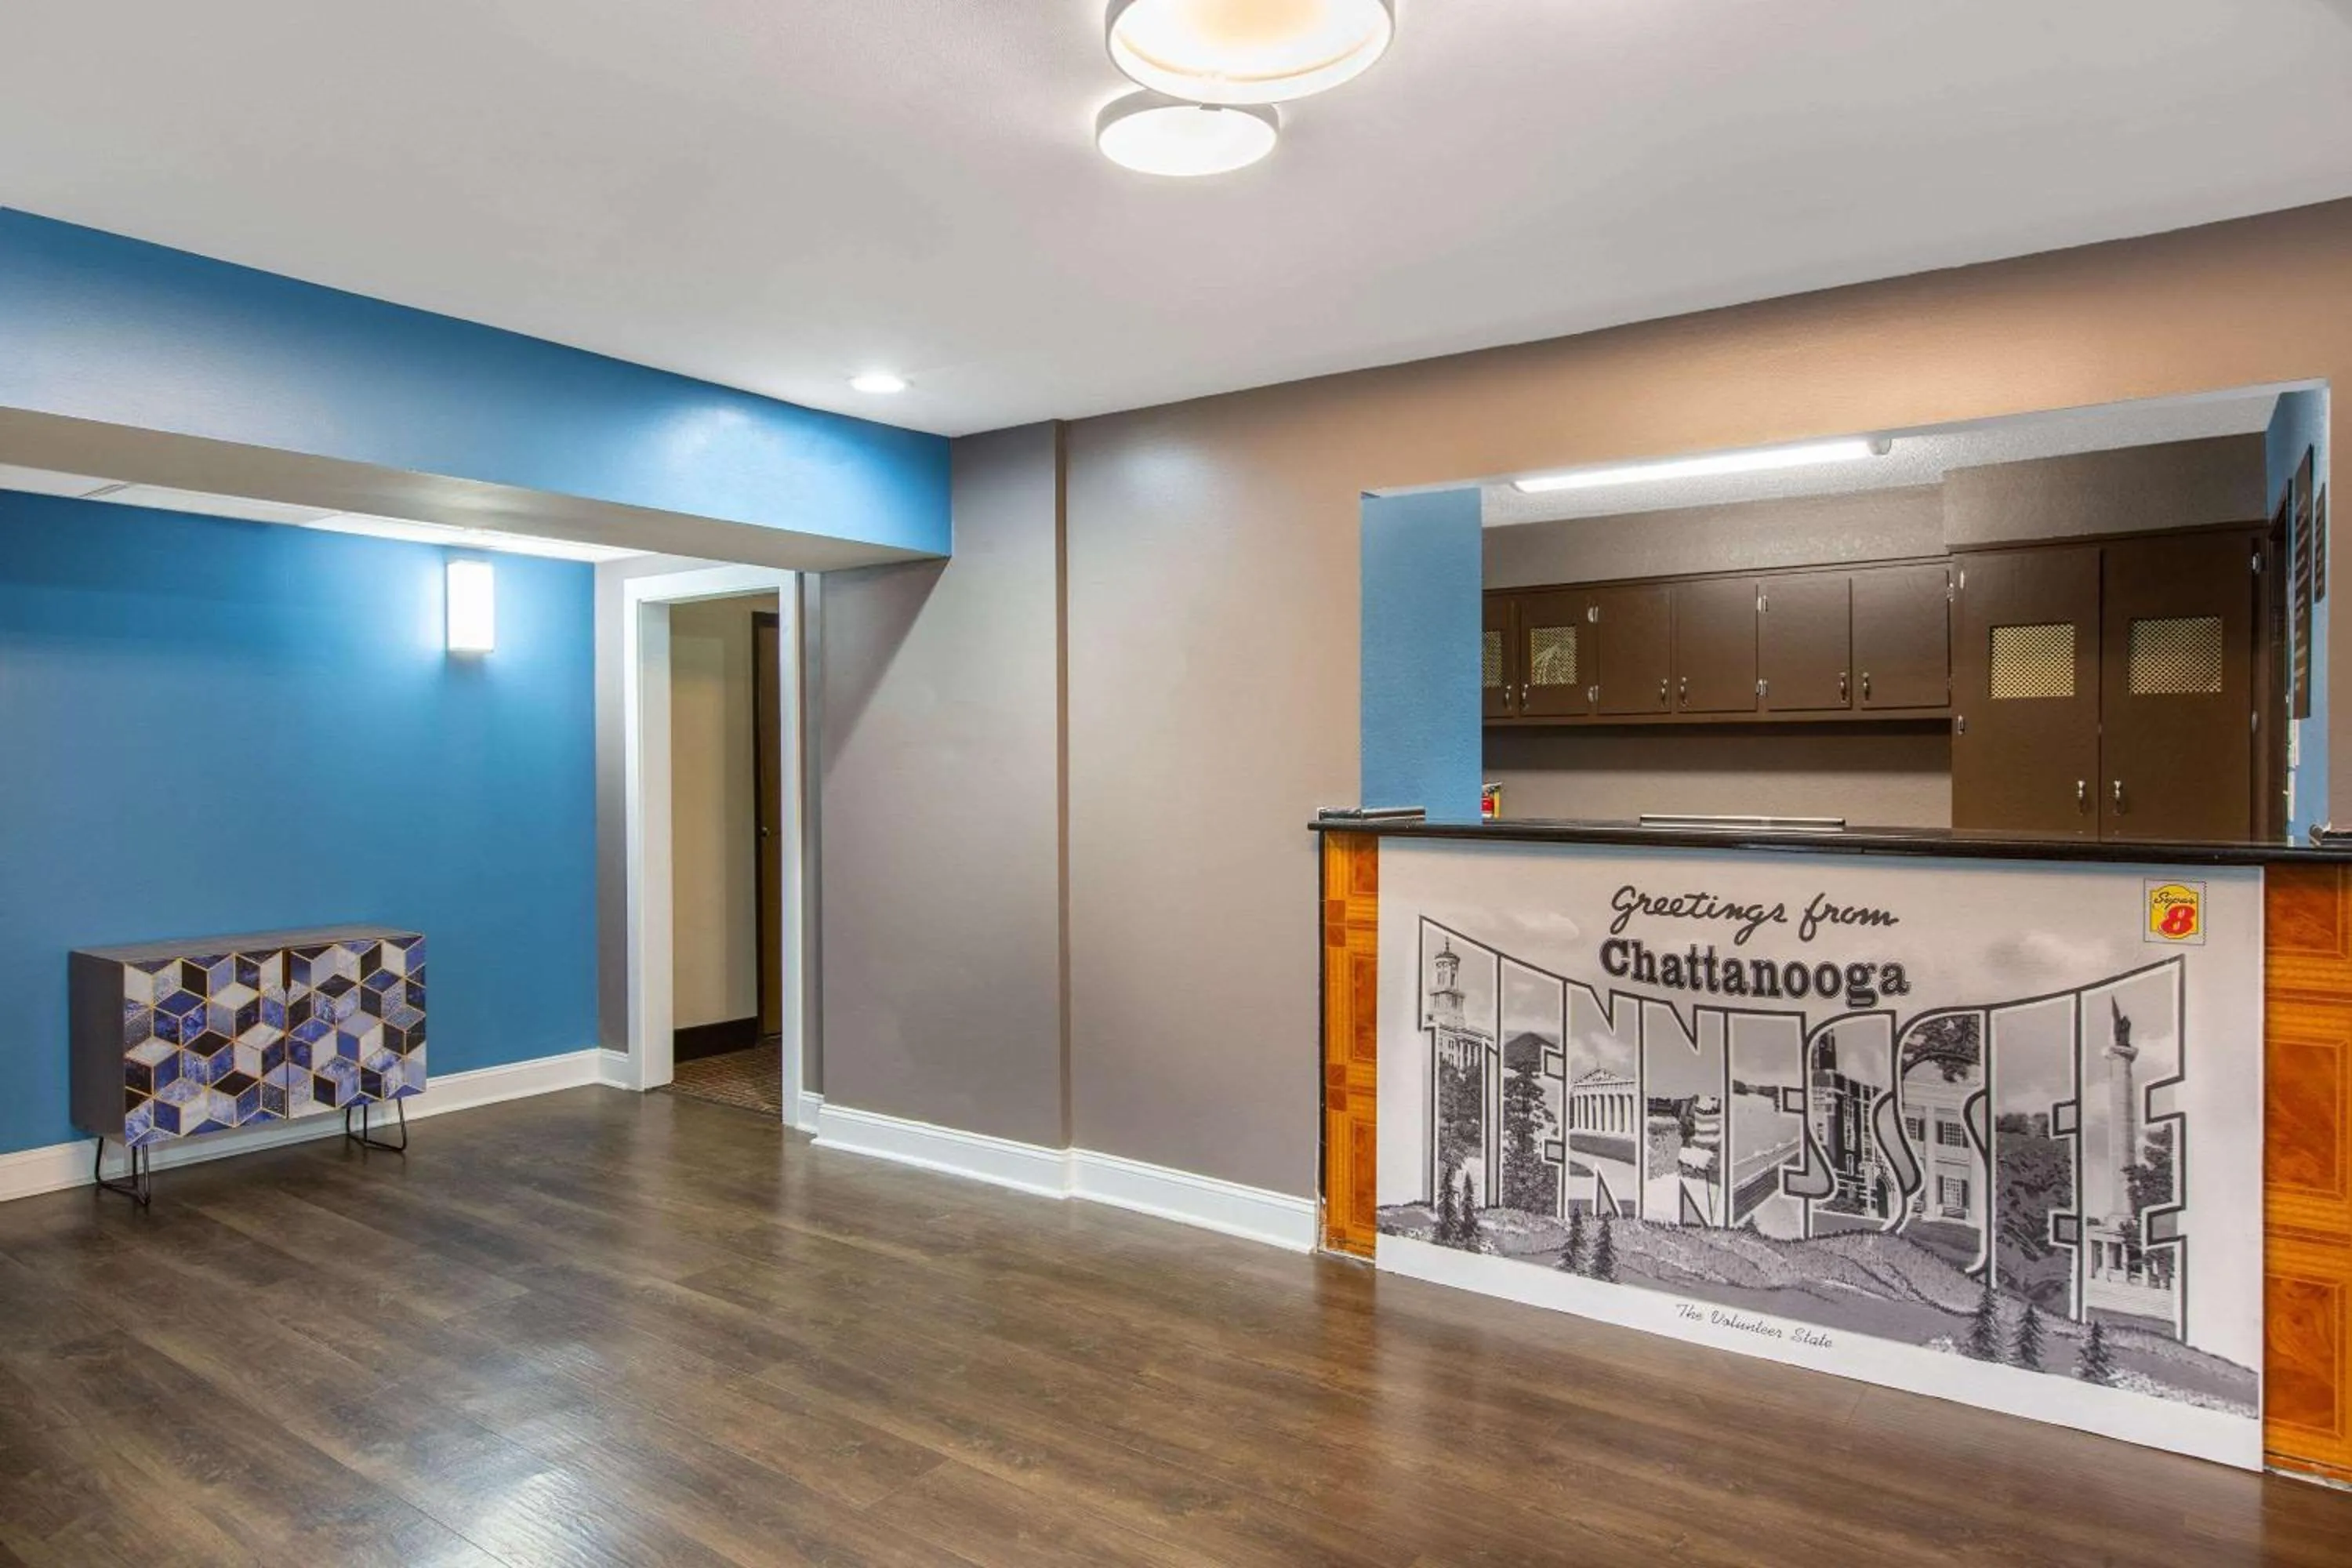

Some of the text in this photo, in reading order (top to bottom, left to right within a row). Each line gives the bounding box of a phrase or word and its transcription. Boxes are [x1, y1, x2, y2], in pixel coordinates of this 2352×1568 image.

[1610, 884, 1900, 946] Greetings from
[2160, 904, 2196, 935] 8
[1599, 938, 1911, 1010] Chattanooga
[1675, 1303, 1833, 1348] The Volunteer State
